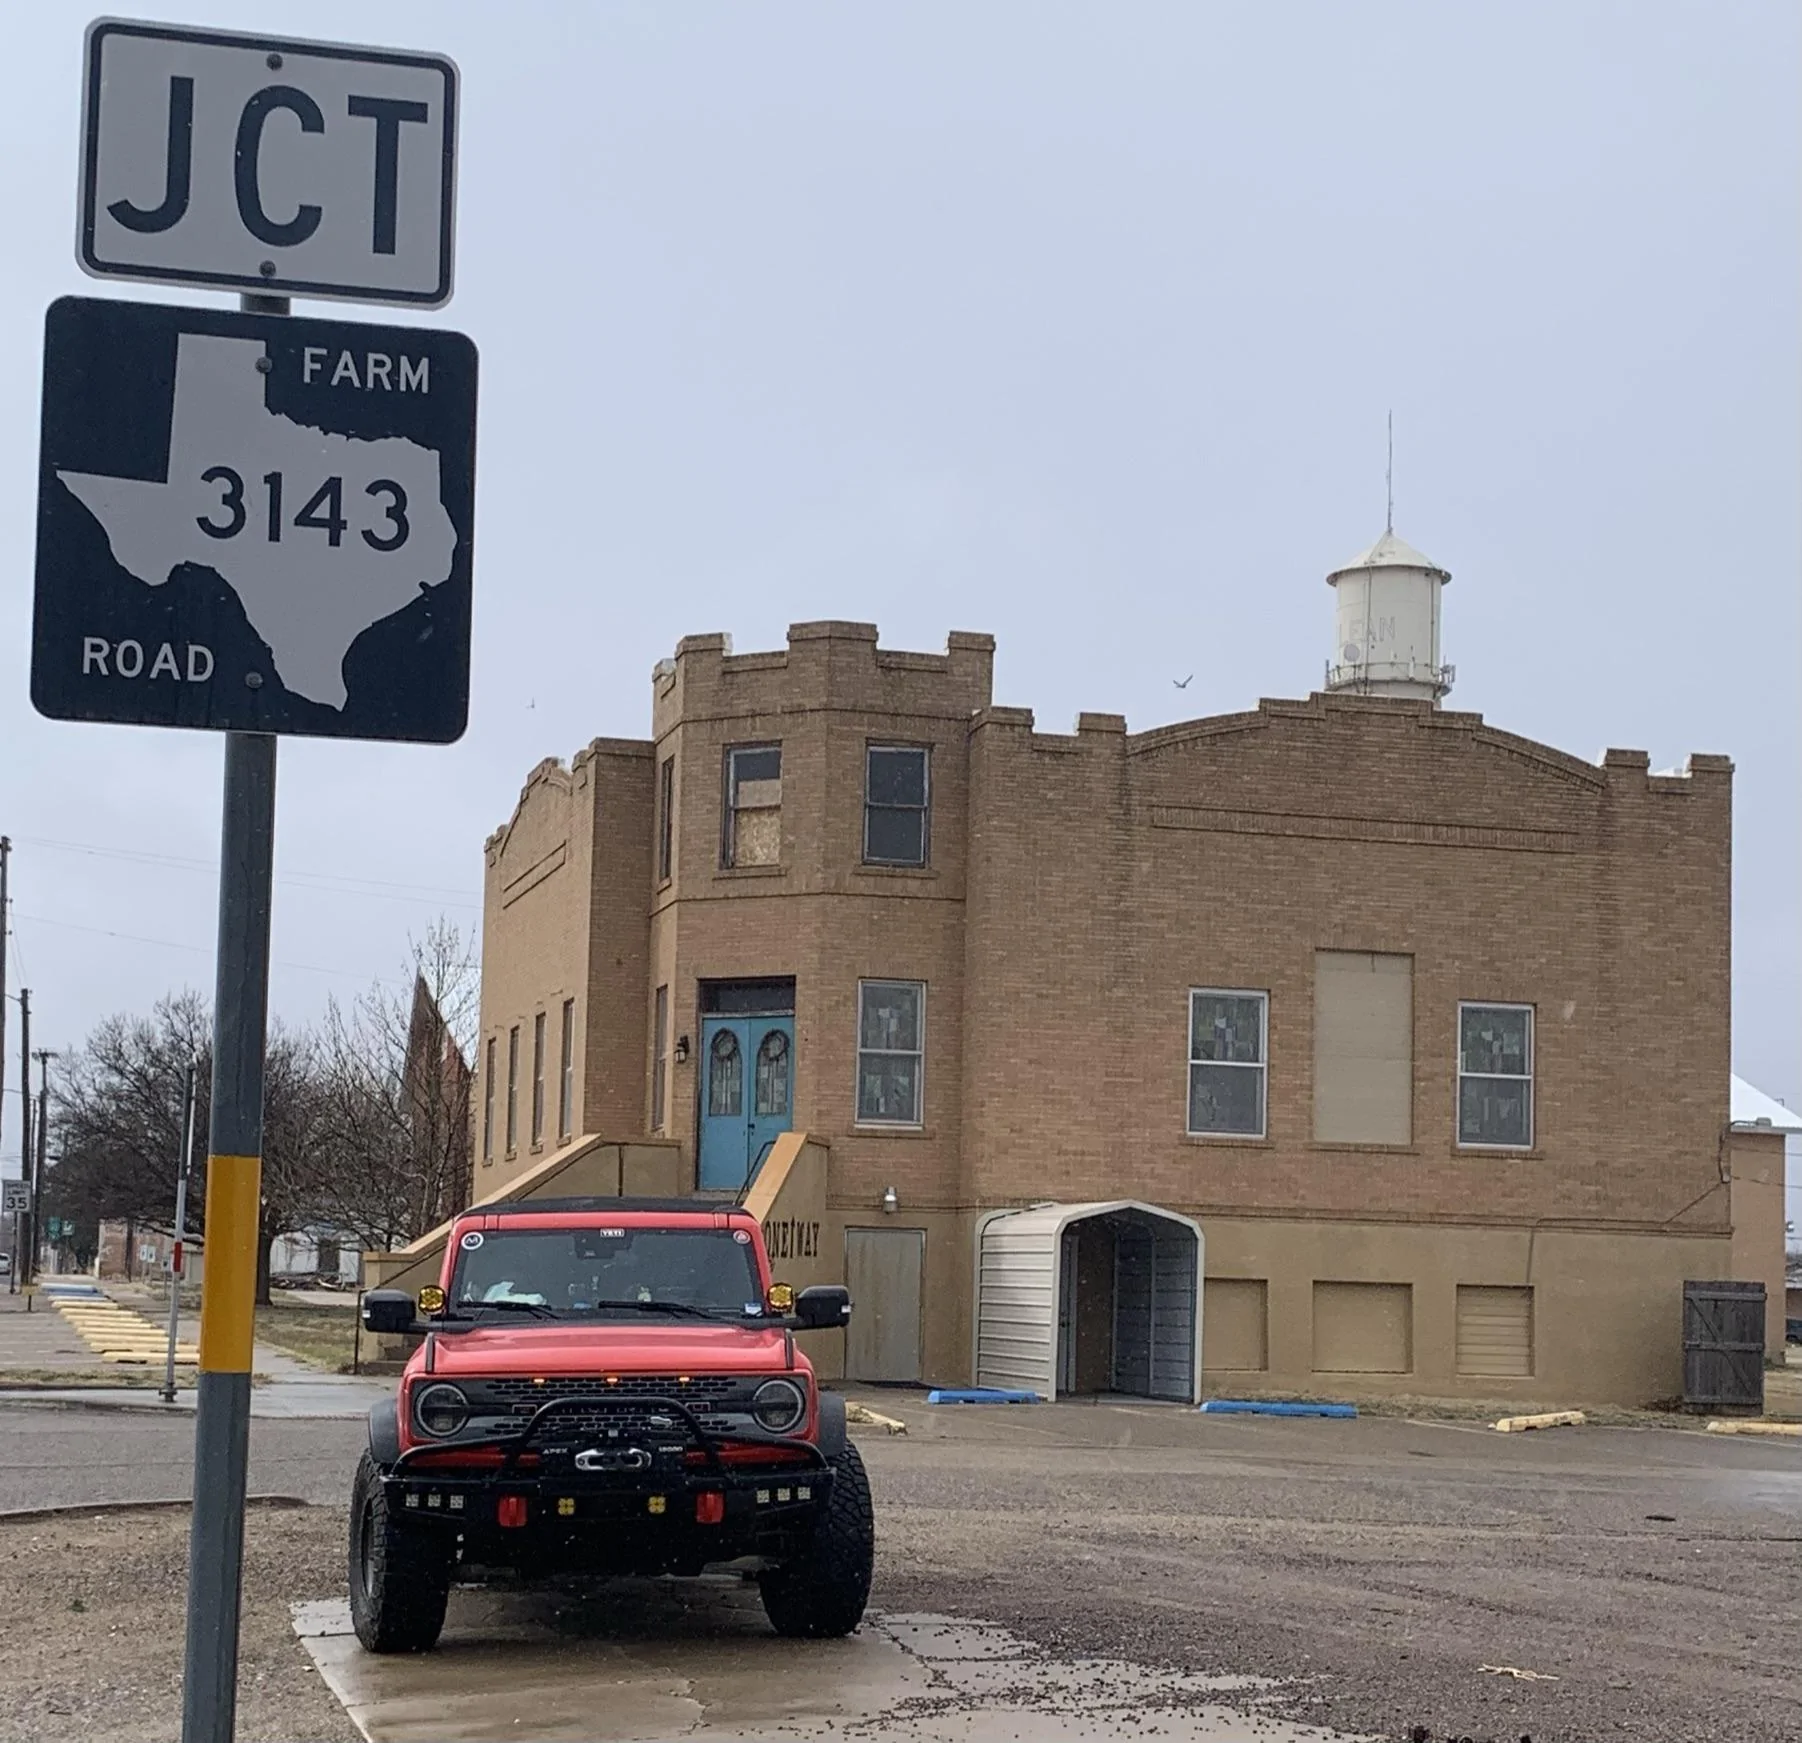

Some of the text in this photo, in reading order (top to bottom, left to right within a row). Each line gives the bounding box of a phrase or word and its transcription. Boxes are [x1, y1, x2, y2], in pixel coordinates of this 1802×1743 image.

[106, 75, 429, 256] JCT
[302, 347, 431, 394] FARM
[195, 465, 411, 553] 3143
[82, 637, 215, 684] ROAD
[6, 1197, 27, 1209] 35
